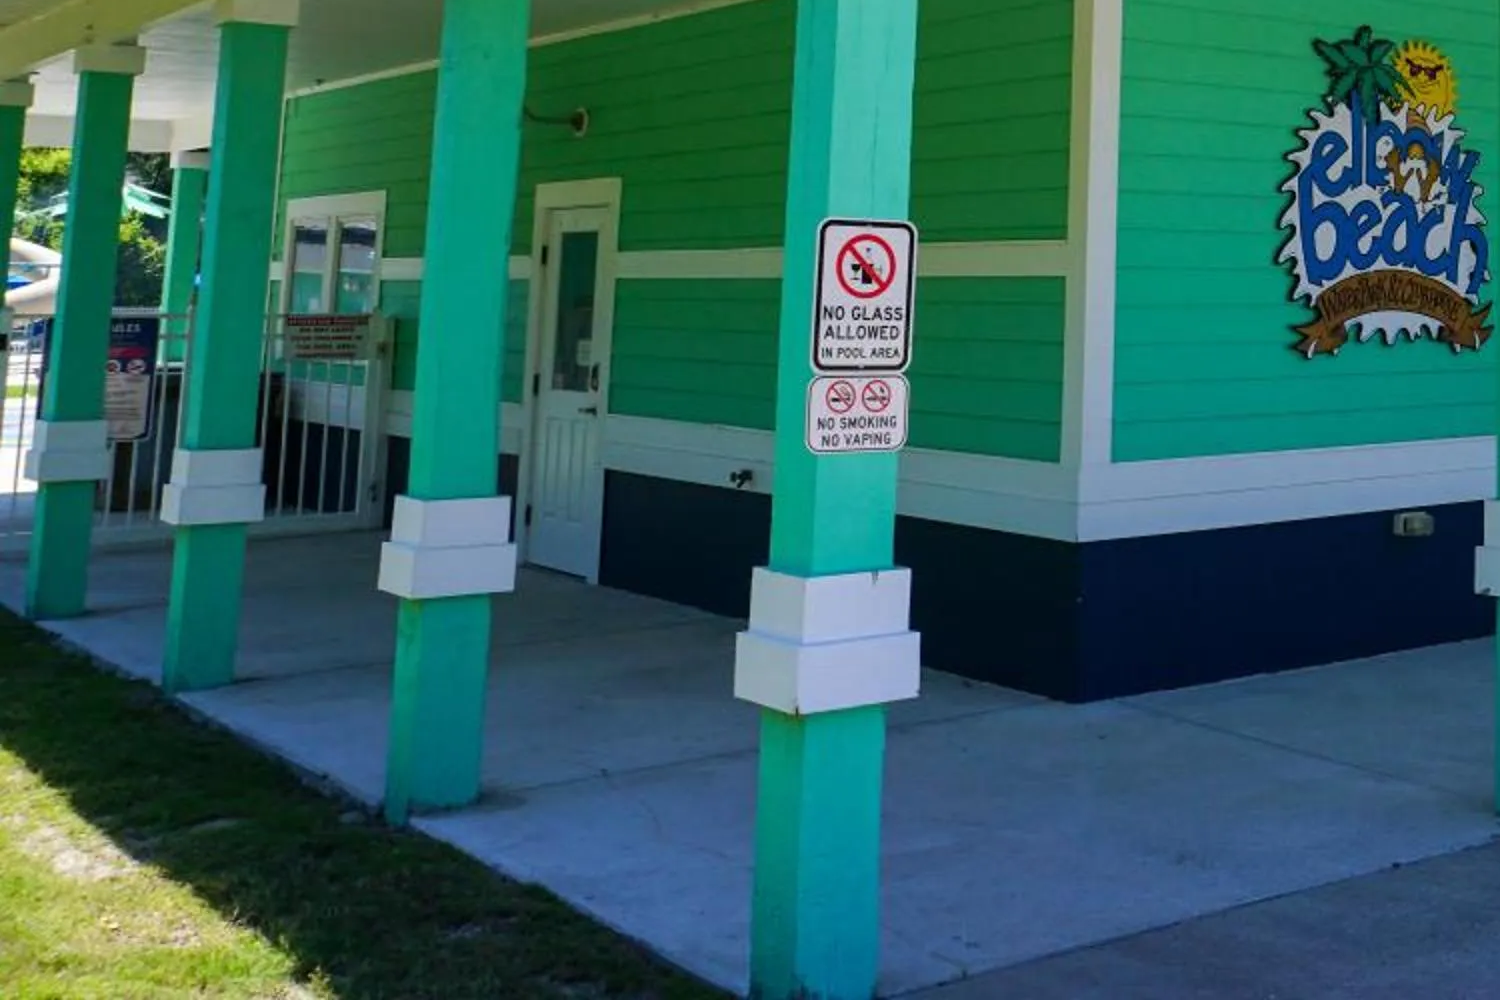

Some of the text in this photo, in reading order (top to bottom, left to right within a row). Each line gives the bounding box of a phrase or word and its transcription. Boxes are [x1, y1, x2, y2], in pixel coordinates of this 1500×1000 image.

[1298, 168, 1489, 296] beach
[823, 305, 903, 321] NO GLASS
[823, 325, 900, 340] ALLOWED
[821, 347, 901, 359] IN POOL AREA
[817, 415, 897, 430] NO SMOKING
[821, 432, 891, 447] NO VAPING
